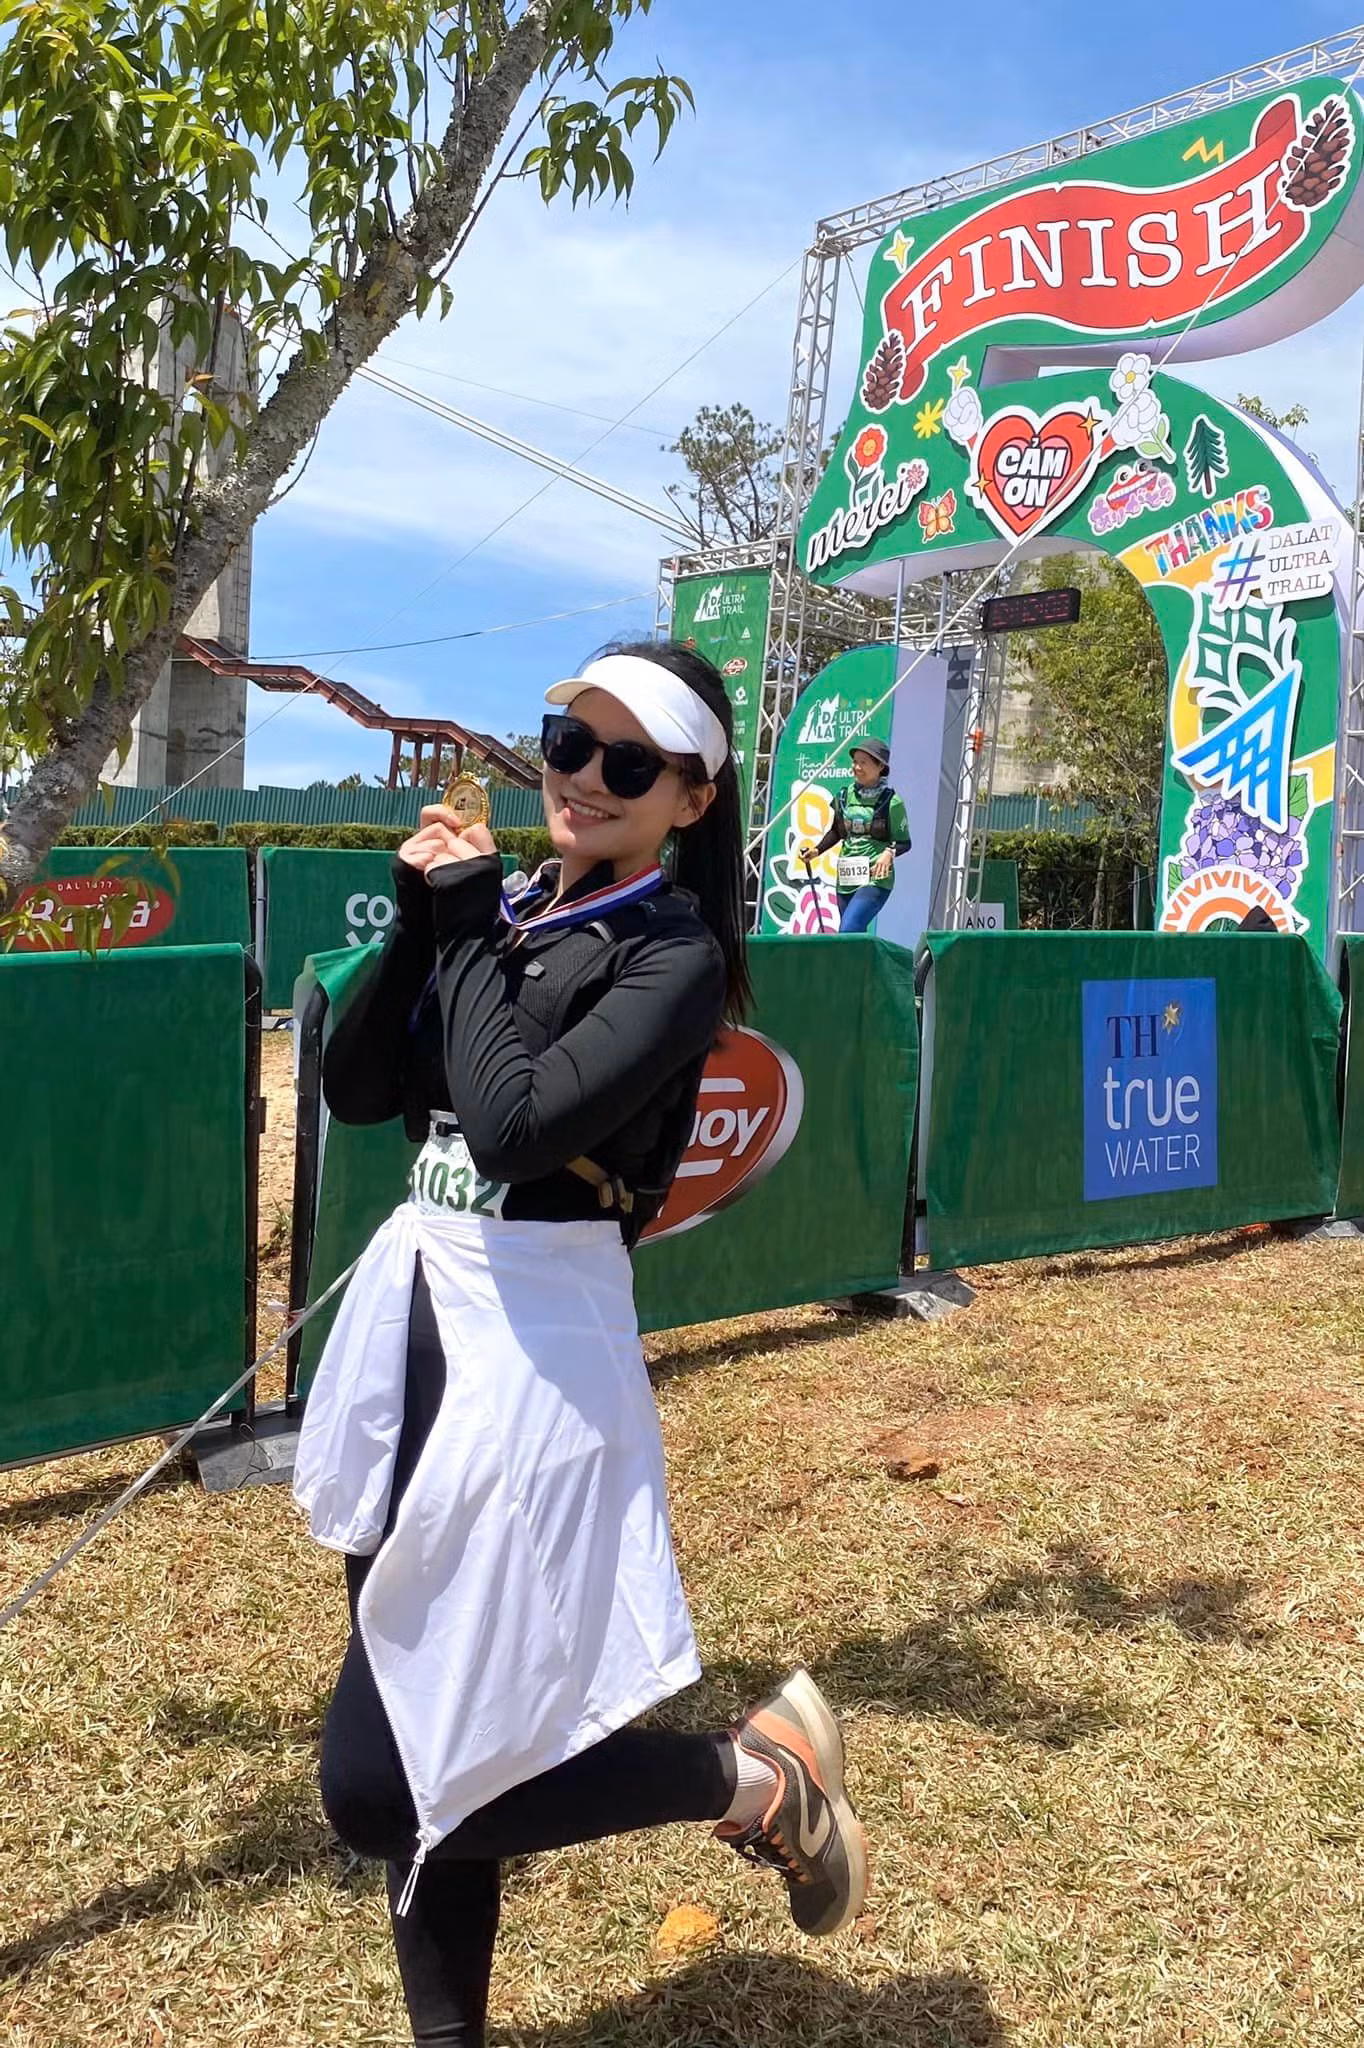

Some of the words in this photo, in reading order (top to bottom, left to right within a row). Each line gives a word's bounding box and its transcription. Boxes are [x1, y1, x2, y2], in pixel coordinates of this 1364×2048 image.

[901, 161, 1282, 343] FINISH
[808, 467, 911, 567] merci
[1145, 489, 1273, 577] THANKS
[1270, 525, 1332, 549] DALAT
[1269, 549, 1332, 573] ULTRA
[722, 593, 746, 605] ULTRA
[1268, 574, 1326, 596] TRAIL
[722, 605, 745, 615] TRAIL
[57, 881, 80, 891] DAL
[1106, 1014, 1160, 1059] TH
[1103, 1066, 1200, 1130] true
[1105, 1134, 1200, 1178] WATER
